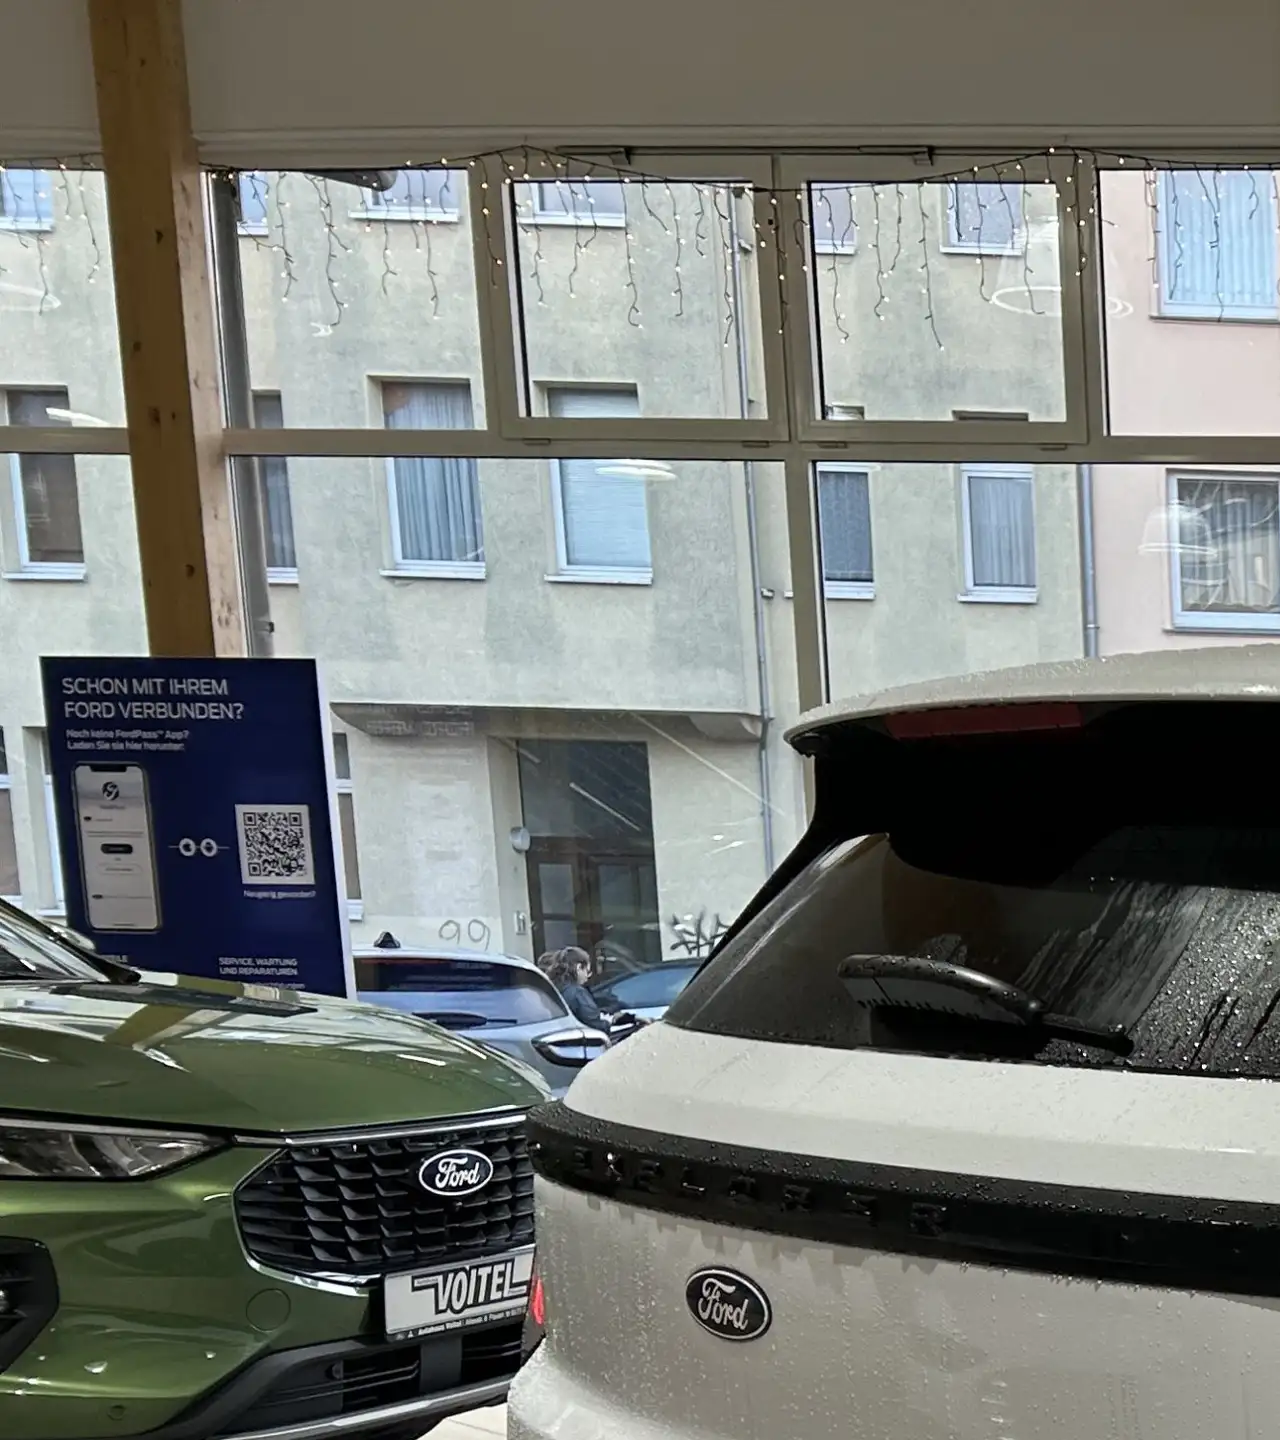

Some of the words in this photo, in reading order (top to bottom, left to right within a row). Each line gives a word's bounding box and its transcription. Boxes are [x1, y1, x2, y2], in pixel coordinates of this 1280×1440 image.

[62, 677, 127, 694] SCHON
[132, 678, 164, 695] MIT
[169, 679, 228, 695] IHREM
[64, 701, 115, 718] FORD
[118, 702, 244, 719] VERBUNDEN?
[435, 1157, 481, 1188] Ford
[436, 1261, 520, 1310] VOITEL
[698, 1277, 749, 1331] Ford
